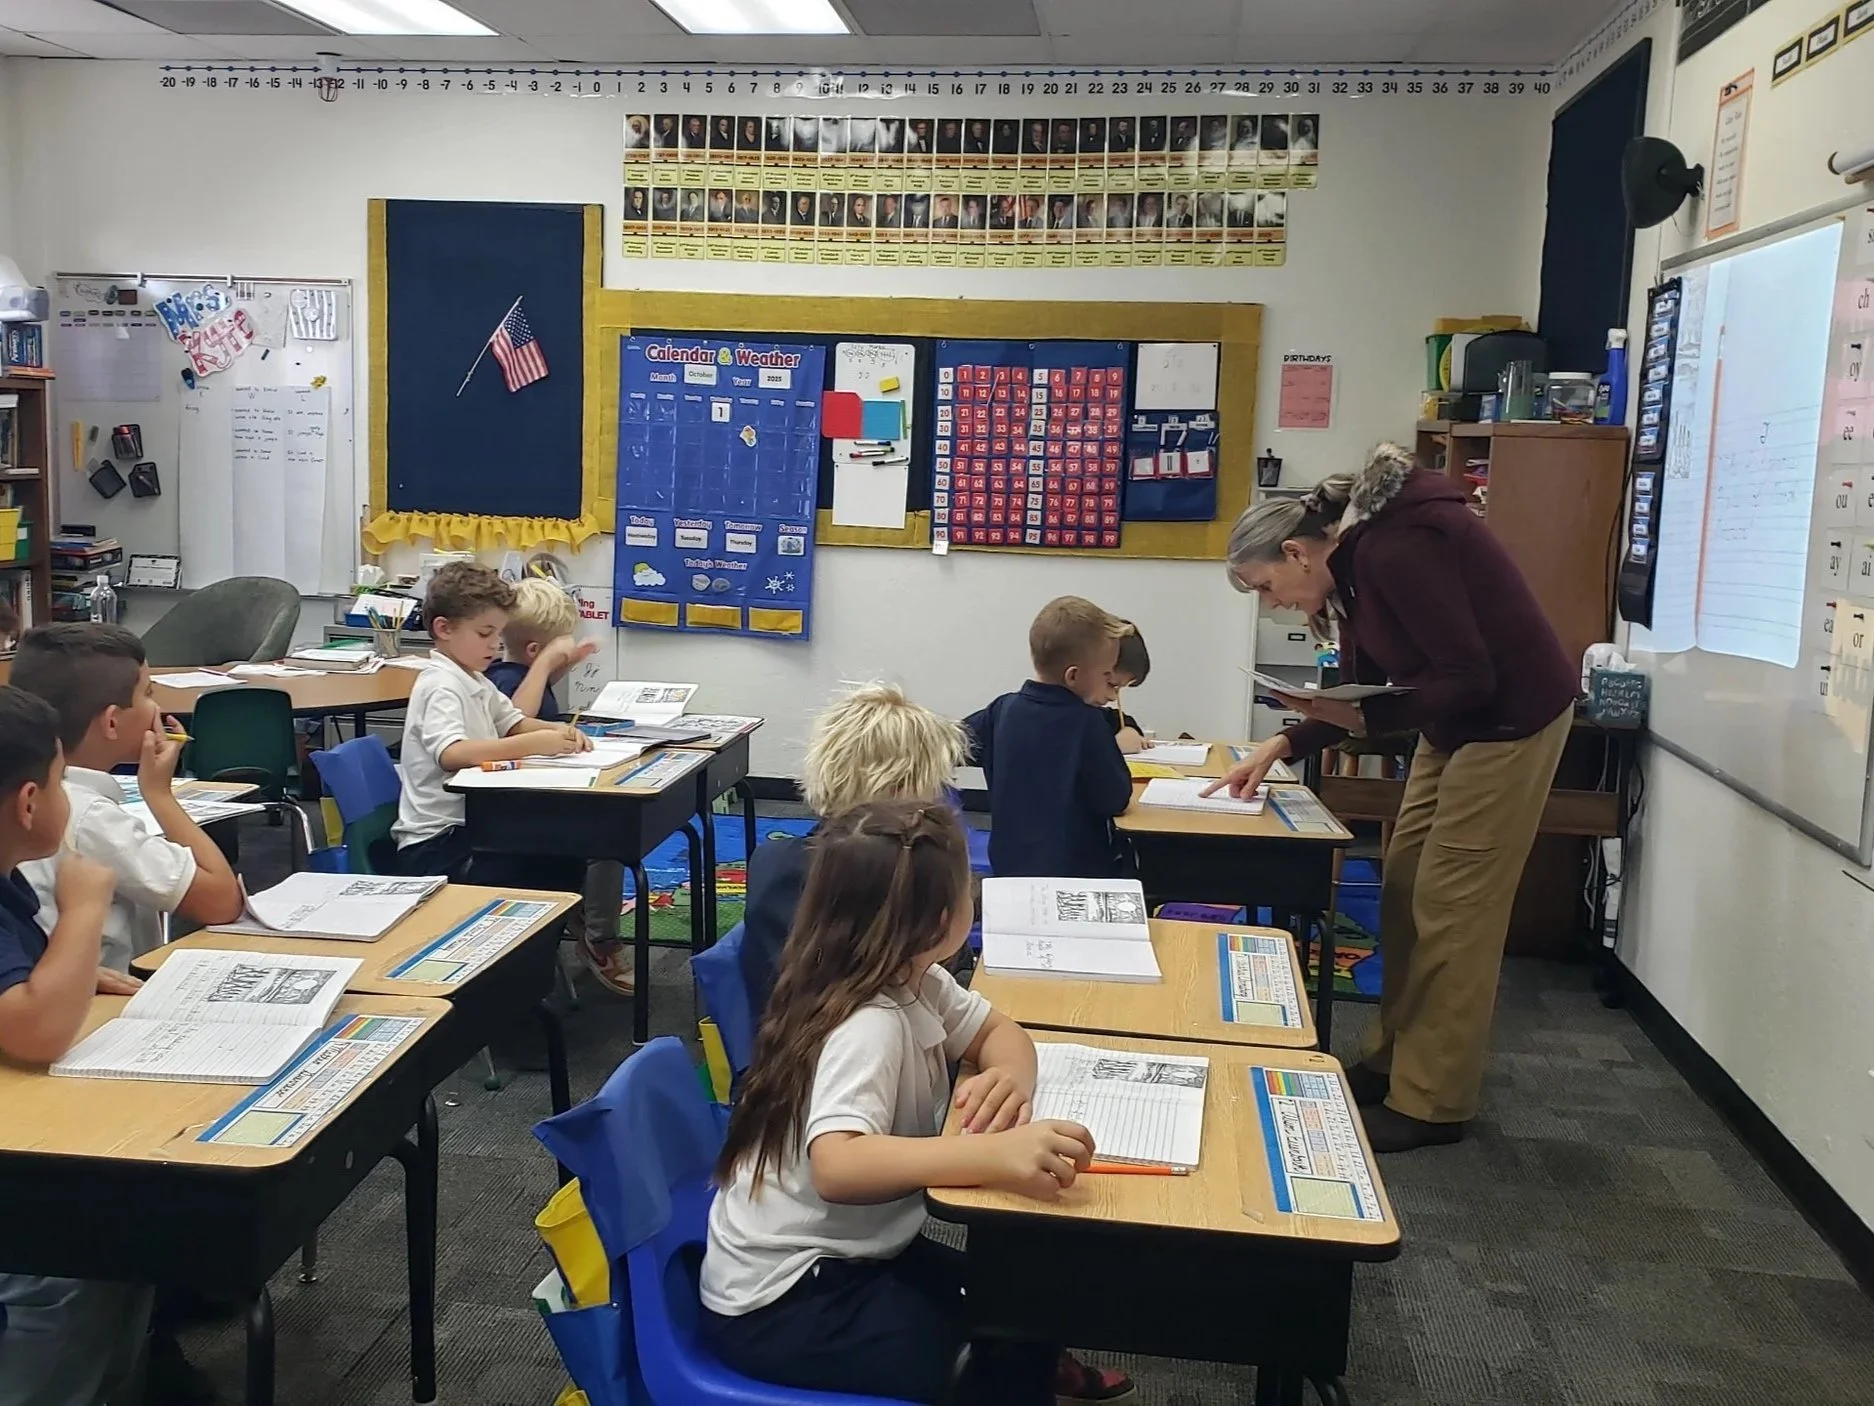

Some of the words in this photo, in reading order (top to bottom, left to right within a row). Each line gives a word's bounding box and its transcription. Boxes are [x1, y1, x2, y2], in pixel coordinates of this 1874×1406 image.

[160, 77, 176, 87] -20
[182, 77, 196, 87] -19
[203, 77, 217, 87] -18
[224, 78, 238, 87] -17
[245, 78, 260, 88] -16
[266, 78, 280, 88] -15
[287, 78, 302, 88] -14
[308, 78, 323, 88] -13
[352, 78, 364, 89] -11
[373, 79, 388, 89] -10
[396, 79, 407, 89] -9
[417, 79, 429, 90] -8
[440, 80, 451, 90] -7
[461, 80, 473, 90] -6
[483, 80, 495, 90] -5
[505, 80, 517, 91] -4
[528, 81, 538, 91] -3
[550, 81, 561, 92] -2
[573, 82, 581, 92] -1
[594, 82, 600, 92] 0
[616, 82, 622, 93] 1
[638, 82, 645, 92] 2
[660, 82, 667, 93] 3
[683, 82, 690, 93] 4
[706, 82, 712, 93] 5
[728, 82, 735, 93] 6
[750, 83, 758, 93] 7
[774, 83, 780, 93] 8
[859, 83, 869, 93] 12
[881, 84, 893, 94] 13
[905, 83, 916, 93] 14
[928, 83, 939, 94] 15
[952, 83, 963, 94] 16
[975, 84, 987, 94] 17
[999, 83, 1010, 94] 18
[1022, 83, 1034, 94] 19
[1043, 83, 1058, 94] 20
[1065, 83, 1077, 94] 21
[1088, 83, 1104, 94] 22
[1112, 83, 1128, 94] 23
[1137, 82, 1152, 93] 24
[1161, 82, 1177, 93] 25
[1185, 82, 1201, 93] 26
[1210, 82, 1226, 93] 27
[1234, 82, 1250, 93] 28
[1259, 82, 1274, 93] 29
[1284, 82, 1299, 93] 30
[1308, 82, 1320, 93] 31
[1332, 82, 1348, 93] 32
[1357, 82, 1373, 93] 33
[1382, 82, 1397, 93] 34
[1407, 82, 1422, 93] 35
[1432, 82, 1448, 93] 36
[1458, 82, 1474, 93] 37
[1484, 83, 1499, 93] 38
[1509, 83, 1524, 94] 39
[1534, 83, 1550, 94] 40
[1857, 288, 1870, 309] ch
[647, 345, 715, 363] Calendar
[718, 348, 732, 364] &
[736, 350, 800, 367] Weather
[1283, 354, 1332, 362] BIRTHDAYS
[651, 373, 676, 382] Month
[689, 370, 713, 379] October
[733, 377, 751, 386] Year
[943, 371, 950, 379] 0
[963, 371, 967, 379] 1
[980, 371, 986, 380] 2
[999, 371, 1005, 379] 3
[1017, 372, 1023, 380] 4
[1054, 374, 1060, 382] 6
[1076, 371, 1082, 380] 7
[1094, 374, 1100, 382] 8
[1112, 372, 1118, 381] 9
[941, 388, 950, 397] 10
[963, 389, 970, 397] 11
[979, 389, 987, 397] 12
[998, 389, 1006, 398] 13
[1017, 390, 1026, 398] 14
[1055, 389, 1063, 397] 16
[1073, 389, 1080, 397] 17
[1091, 389, 1099, 397] 18
[1110, 390, 1118, 398] 19
[717, 407, 723, 417] 1
[1836, 494, 1848, 509] ou
[631, 516, 654, 526] Today
[674, 518, 712, 529] Yesterday
[725, 521, 762, 531] Tomorrow
[779, 525, 807, 533] Season
[730, 539, 752, 547] Thursday
[685, 558, 713, 568] Today's
[715, 560, 747, 569] Weather
[1830, 556, 1842, 576] ay
[1861, 555, 1872, 576] ai
[1853, 632, 1864, 648] or
